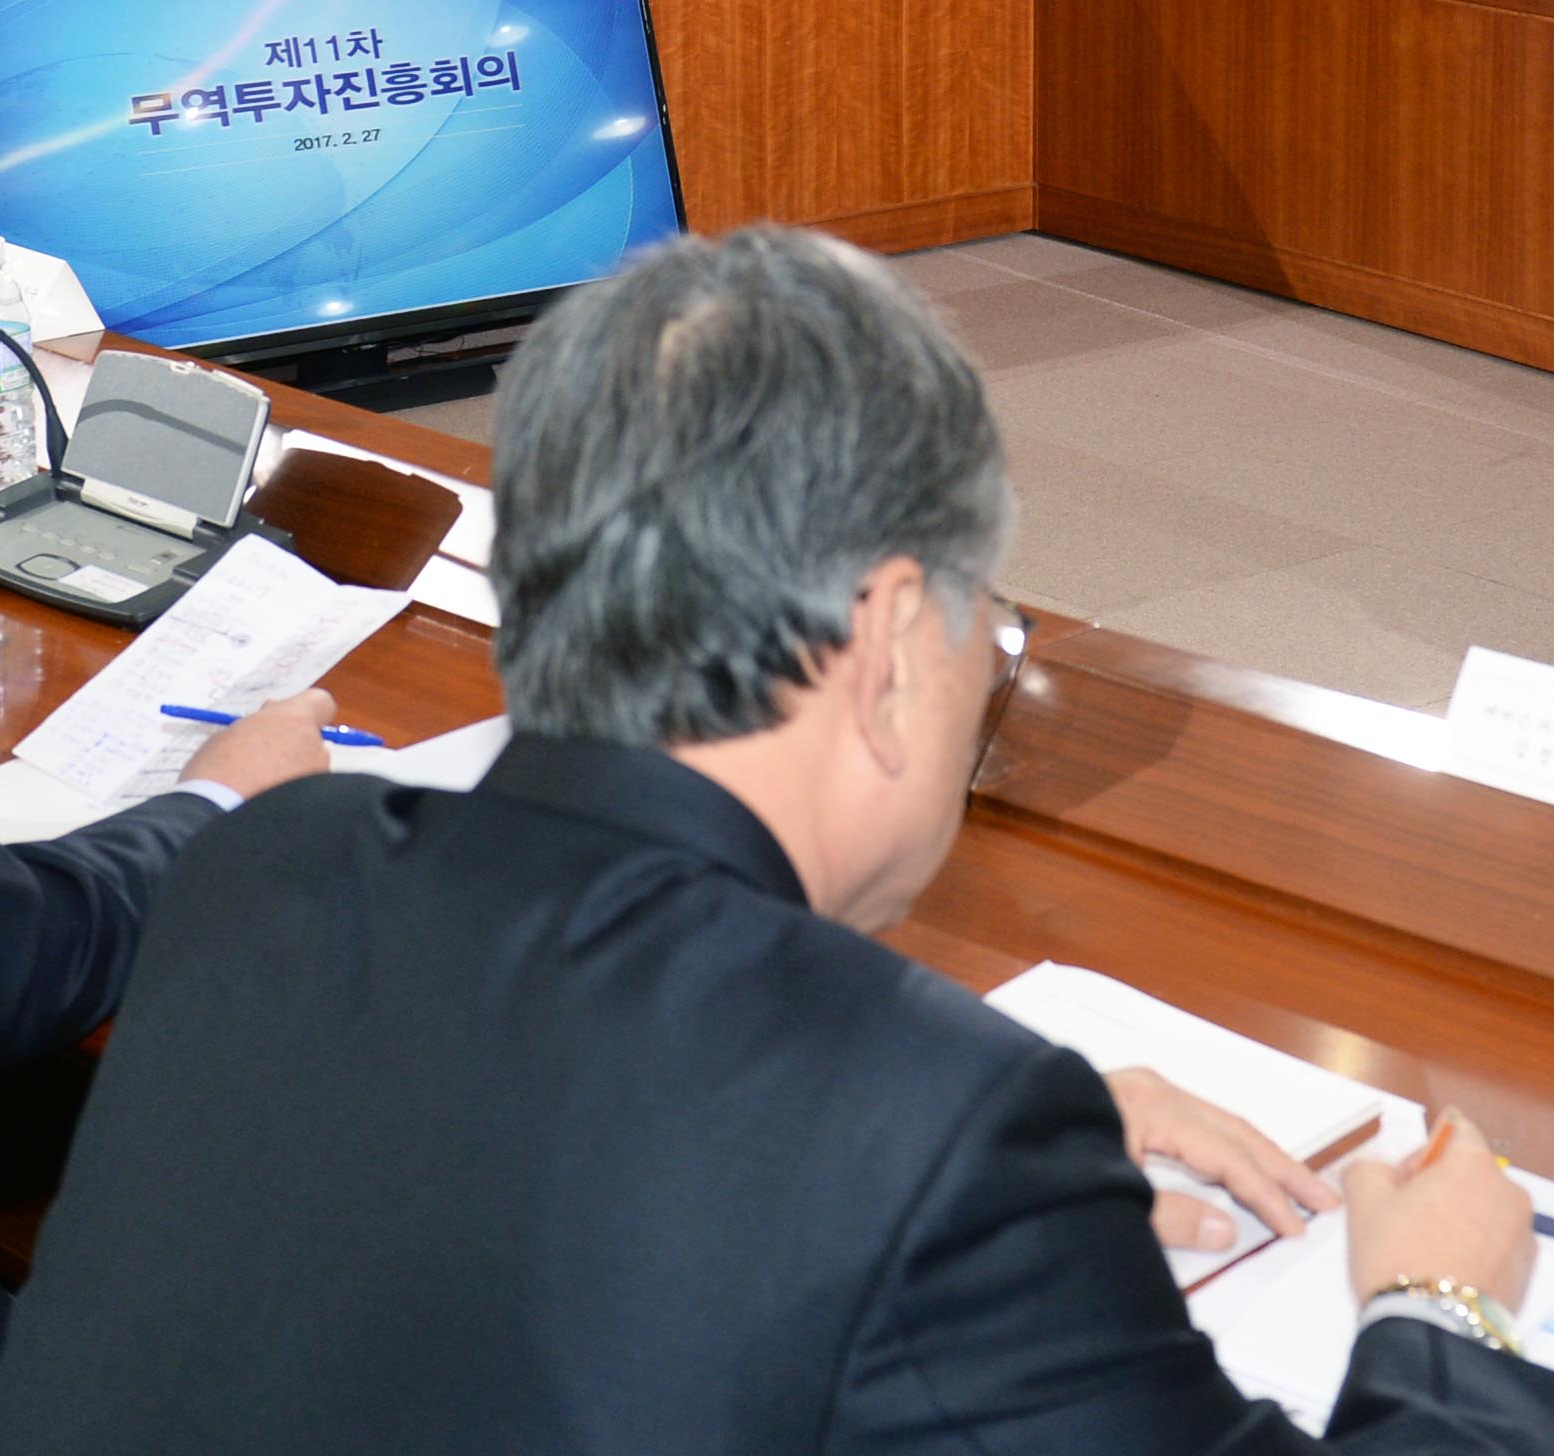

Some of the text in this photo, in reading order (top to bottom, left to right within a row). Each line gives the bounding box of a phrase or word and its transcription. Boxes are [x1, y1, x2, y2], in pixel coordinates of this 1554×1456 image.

[263, 27, 384, 70] 제11차
[127, 50, 522, 136] 무역투자진흥회의
[293, 128, 382, 152] 2017. 2. 27
